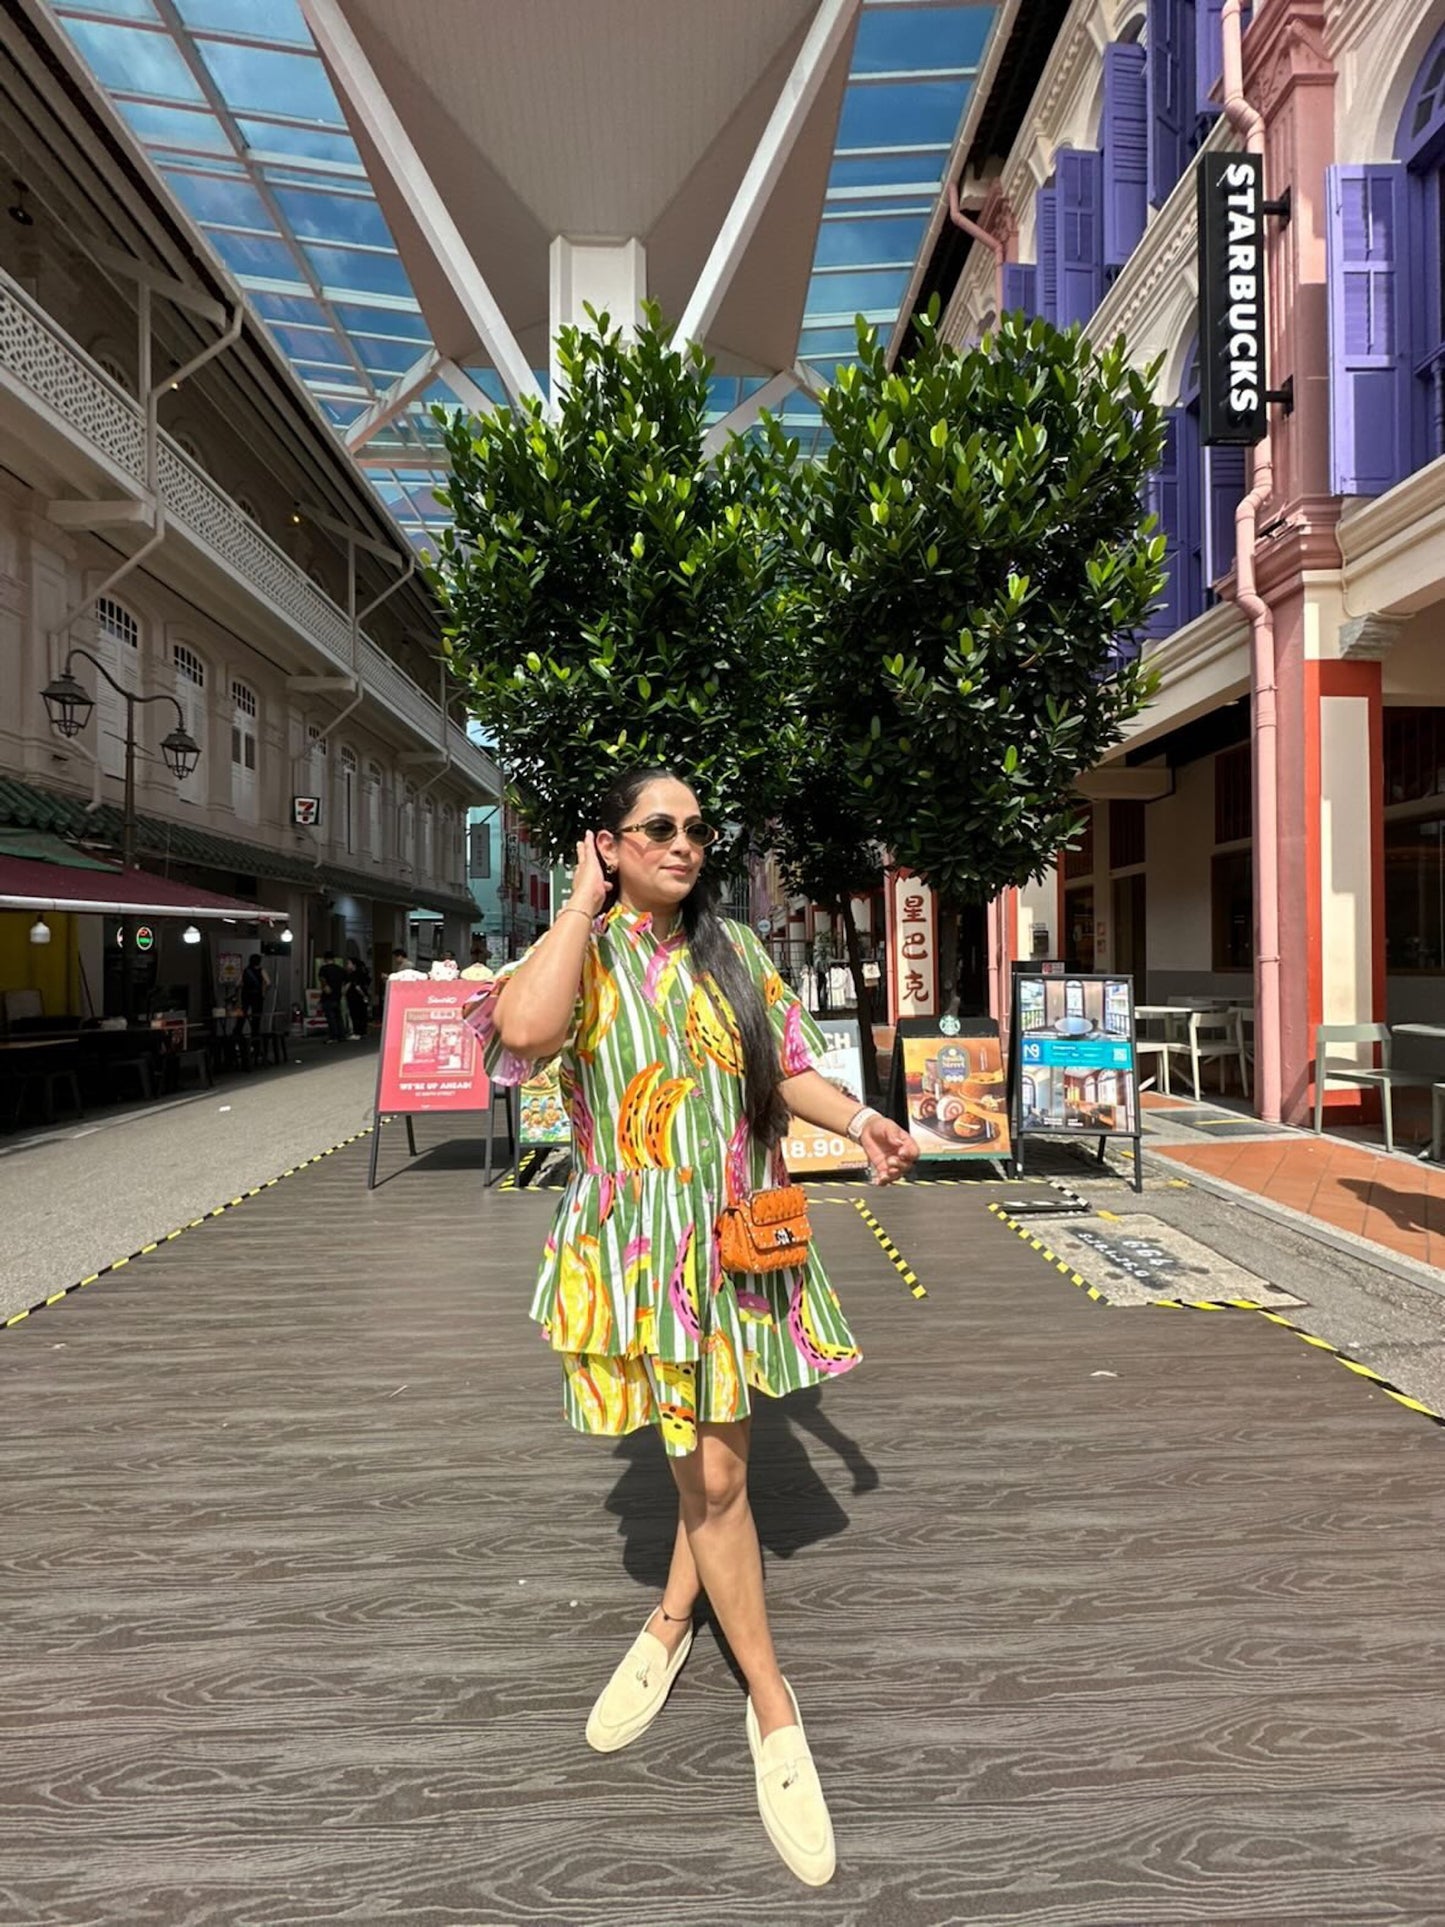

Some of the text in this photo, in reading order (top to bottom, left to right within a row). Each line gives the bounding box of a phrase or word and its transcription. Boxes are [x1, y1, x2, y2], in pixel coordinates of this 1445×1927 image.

[1227, 163, 1258, 411] STARBUCKS
[902, 895, 930, 1002] 星巴克
[426, 1082, 438, 1090] UP
